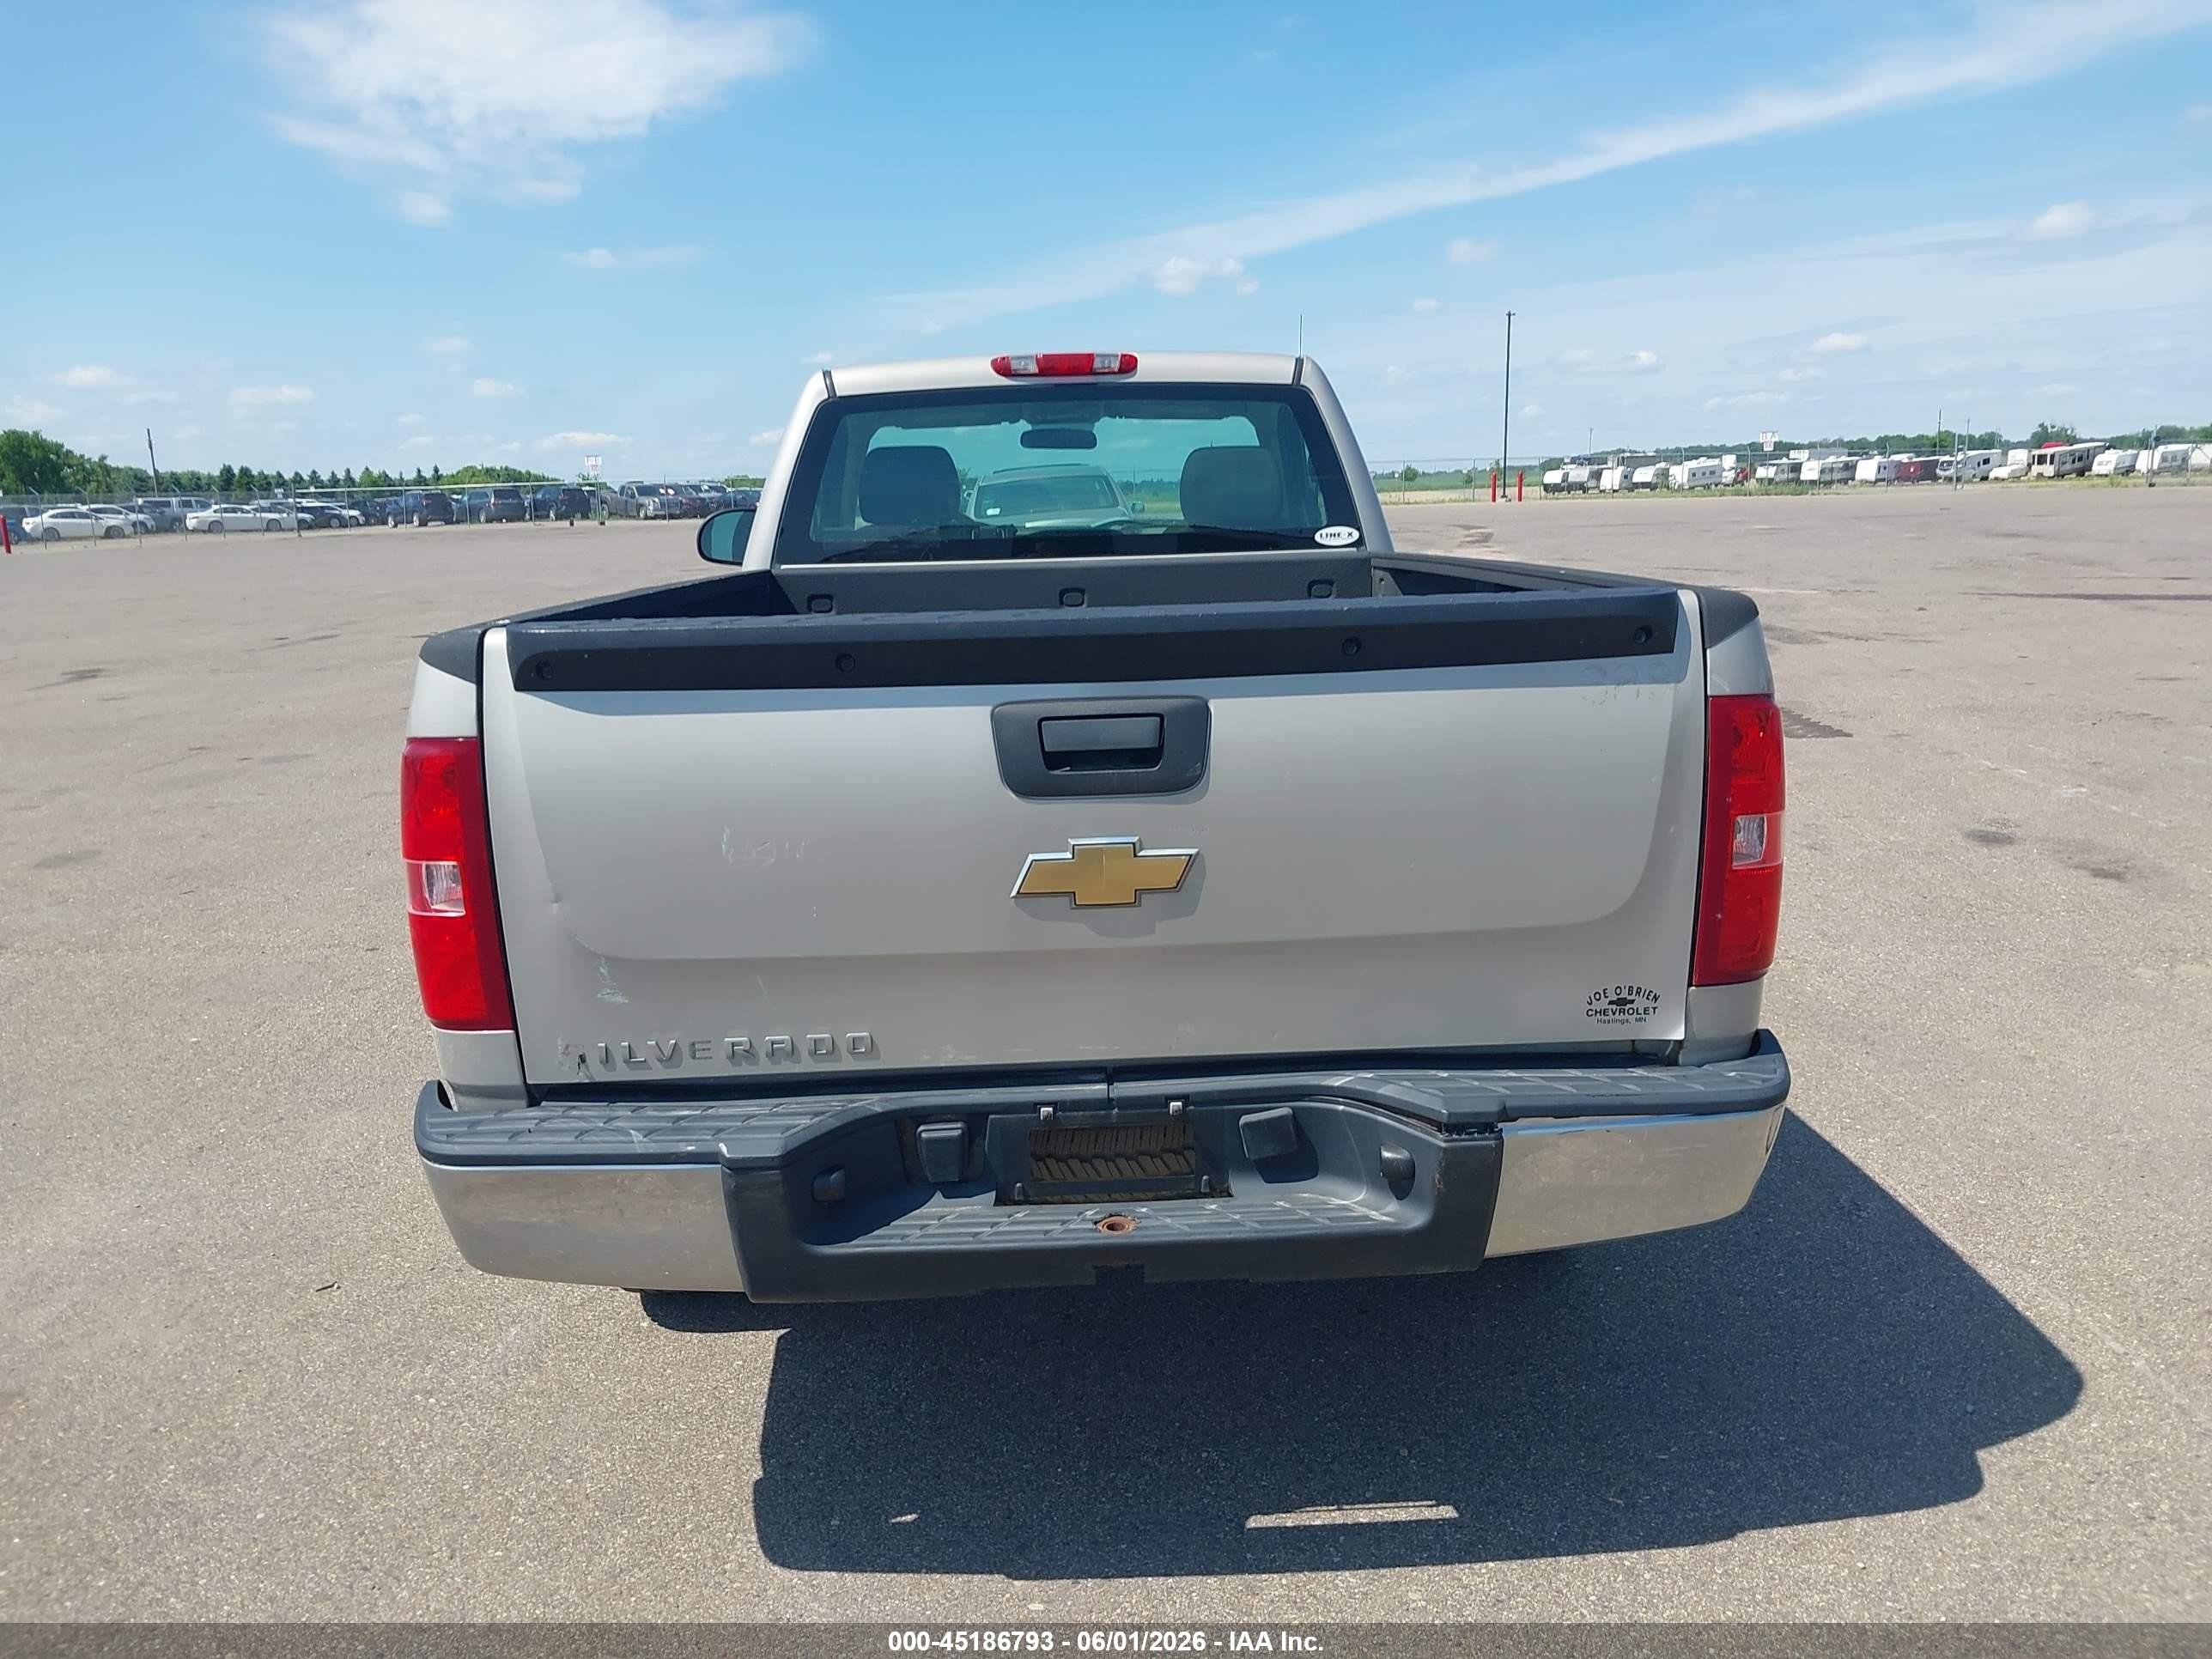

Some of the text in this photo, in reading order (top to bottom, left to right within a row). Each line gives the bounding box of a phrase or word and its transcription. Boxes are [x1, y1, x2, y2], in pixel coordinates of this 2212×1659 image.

[1587, 985, 1661, 1006] JOE O'BRIEN
[1586, 1006, 1658, 1017] CHEVROLET
[561, 1032, 872, 1066] ILVERADO
